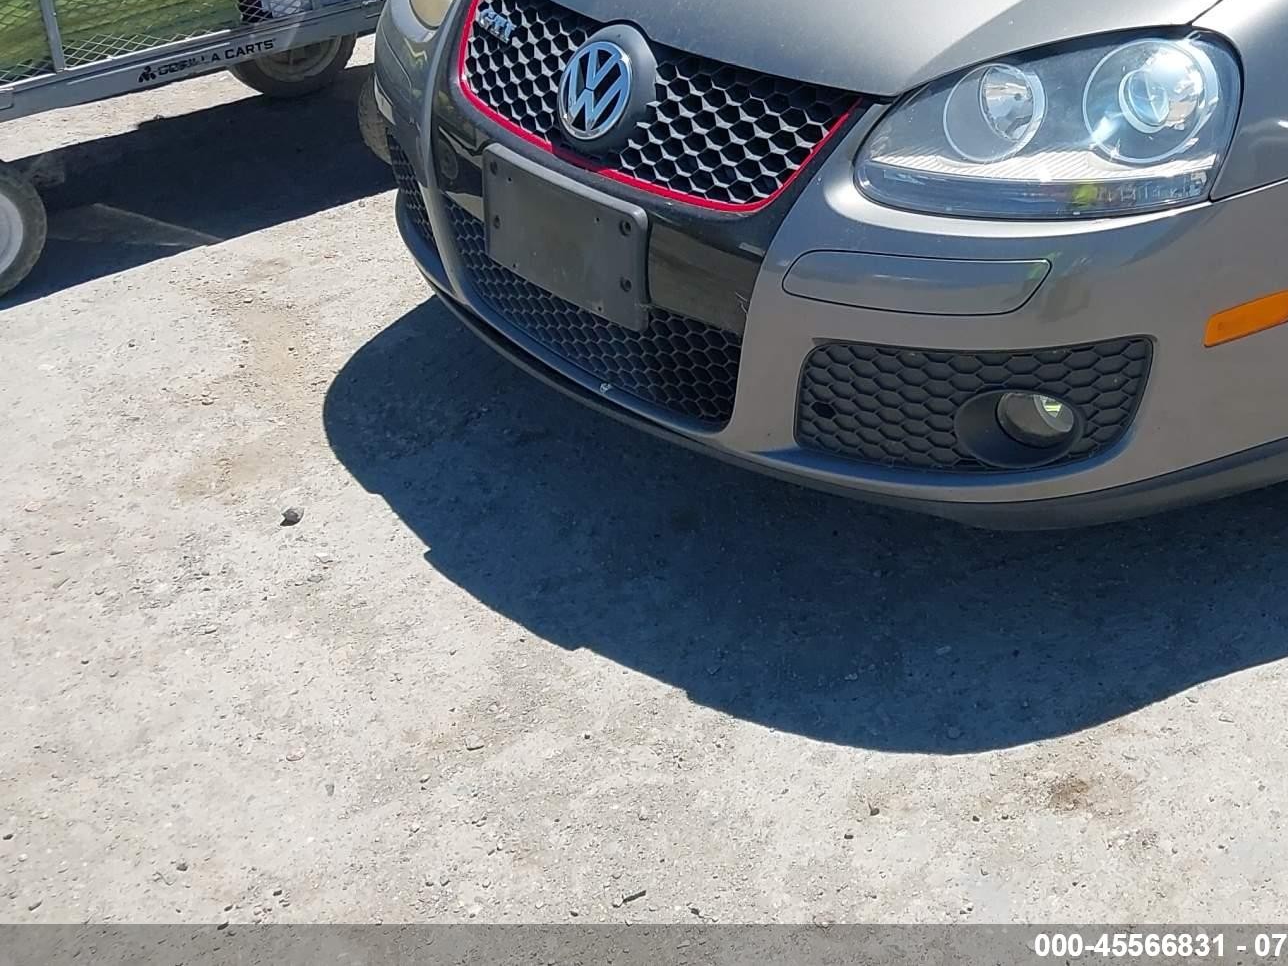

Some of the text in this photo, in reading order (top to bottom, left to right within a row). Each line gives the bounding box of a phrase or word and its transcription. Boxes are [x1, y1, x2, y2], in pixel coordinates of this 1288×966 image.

[481, 8, 516, 44] GTI
[224, 39, 275, 60] CARTS
[559, 40, 632, 140] VW
